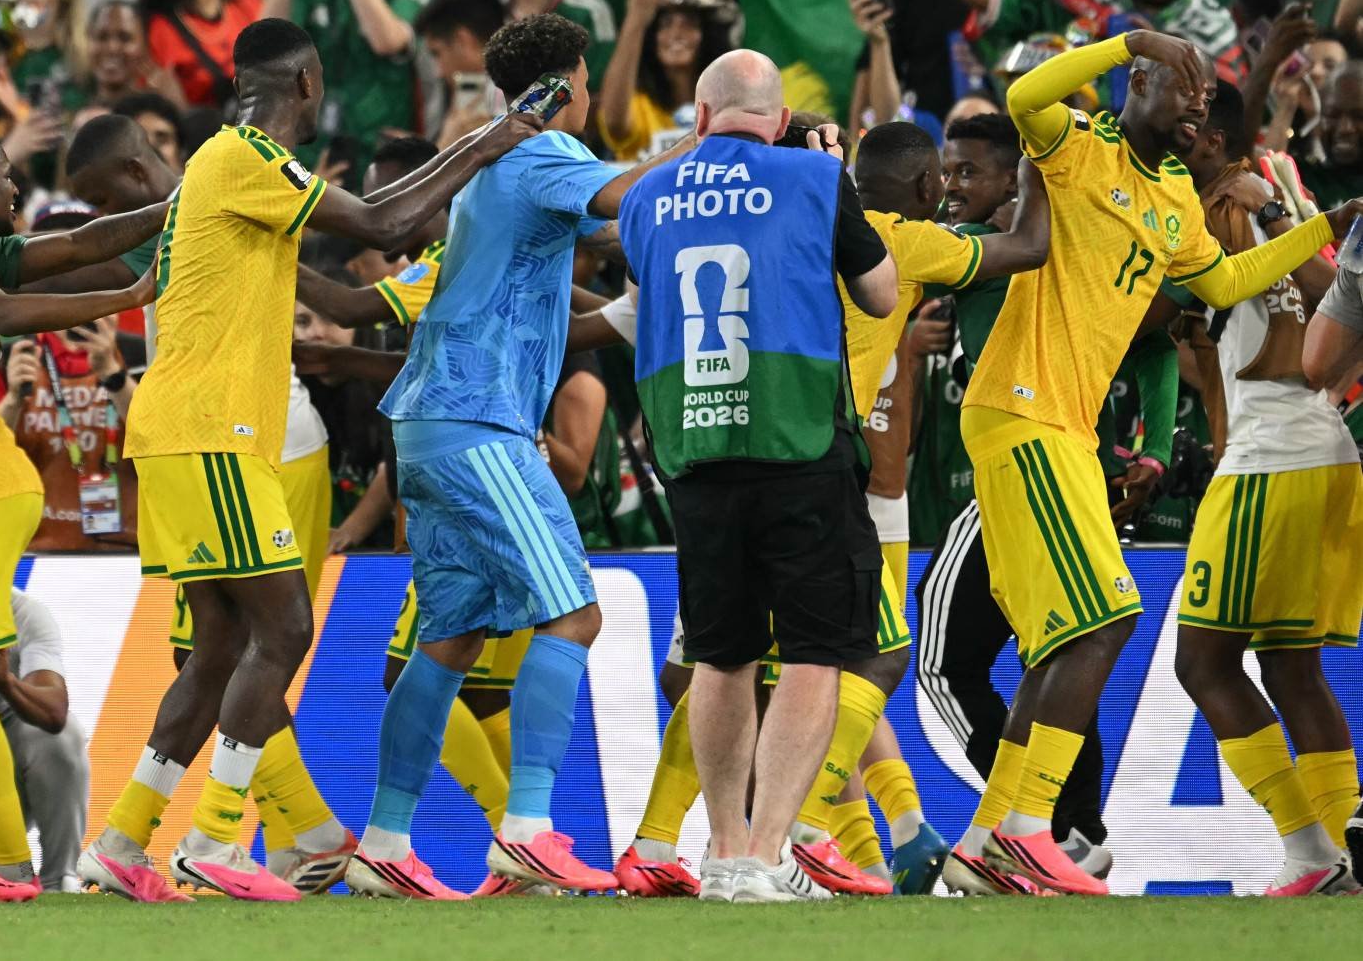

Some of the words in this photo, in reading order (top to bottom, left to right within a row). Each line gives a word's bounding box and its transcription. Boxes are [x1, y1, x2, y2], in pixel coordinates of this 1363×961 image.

[676, 161, 751, 187] FIFA
[655, 187, 773, 225] PHOTO
[1114, 241, 1155, 295] 17
[696, 357, 731, 373] FIFA
[725, 390, 749, 402] CUP
[683, 405, 750, 430] 2026
[1188, 560, 1212, 608] 3
